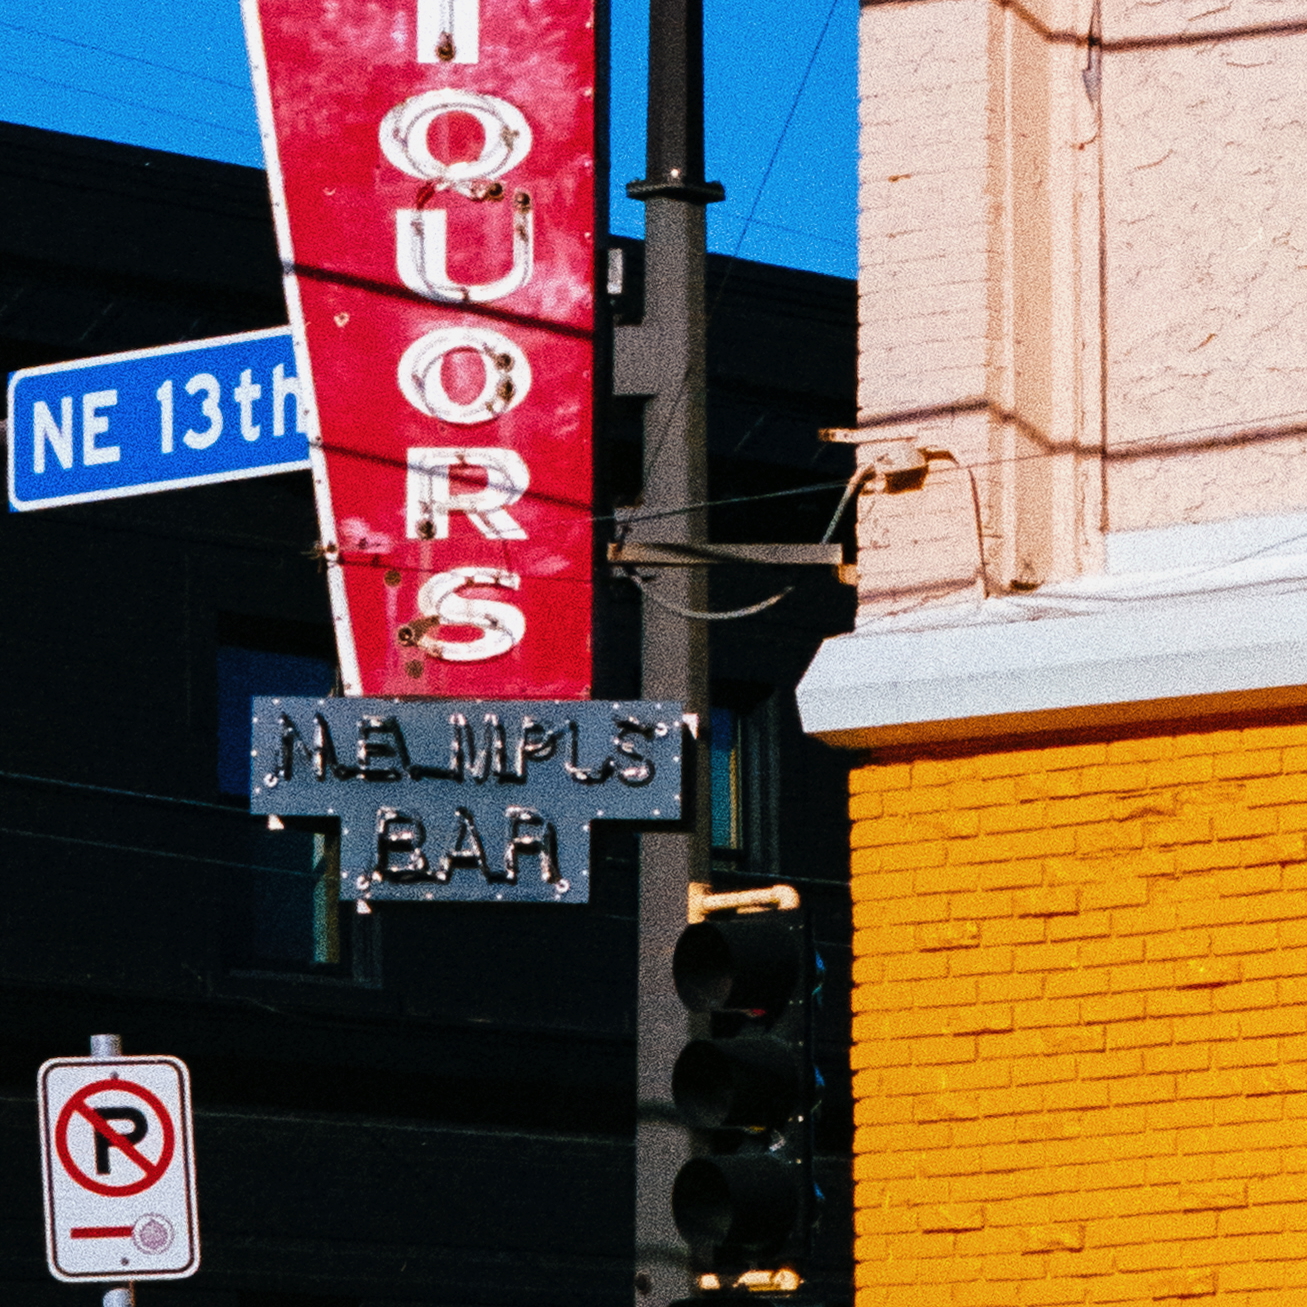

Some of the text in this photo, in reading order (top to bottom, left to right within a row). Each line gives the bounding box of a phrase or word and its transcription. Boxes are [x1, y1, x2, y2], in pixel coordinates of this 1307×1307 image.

[32, 363, 307, 474] NE 13th
[376, 806, 555, 883] BAR
